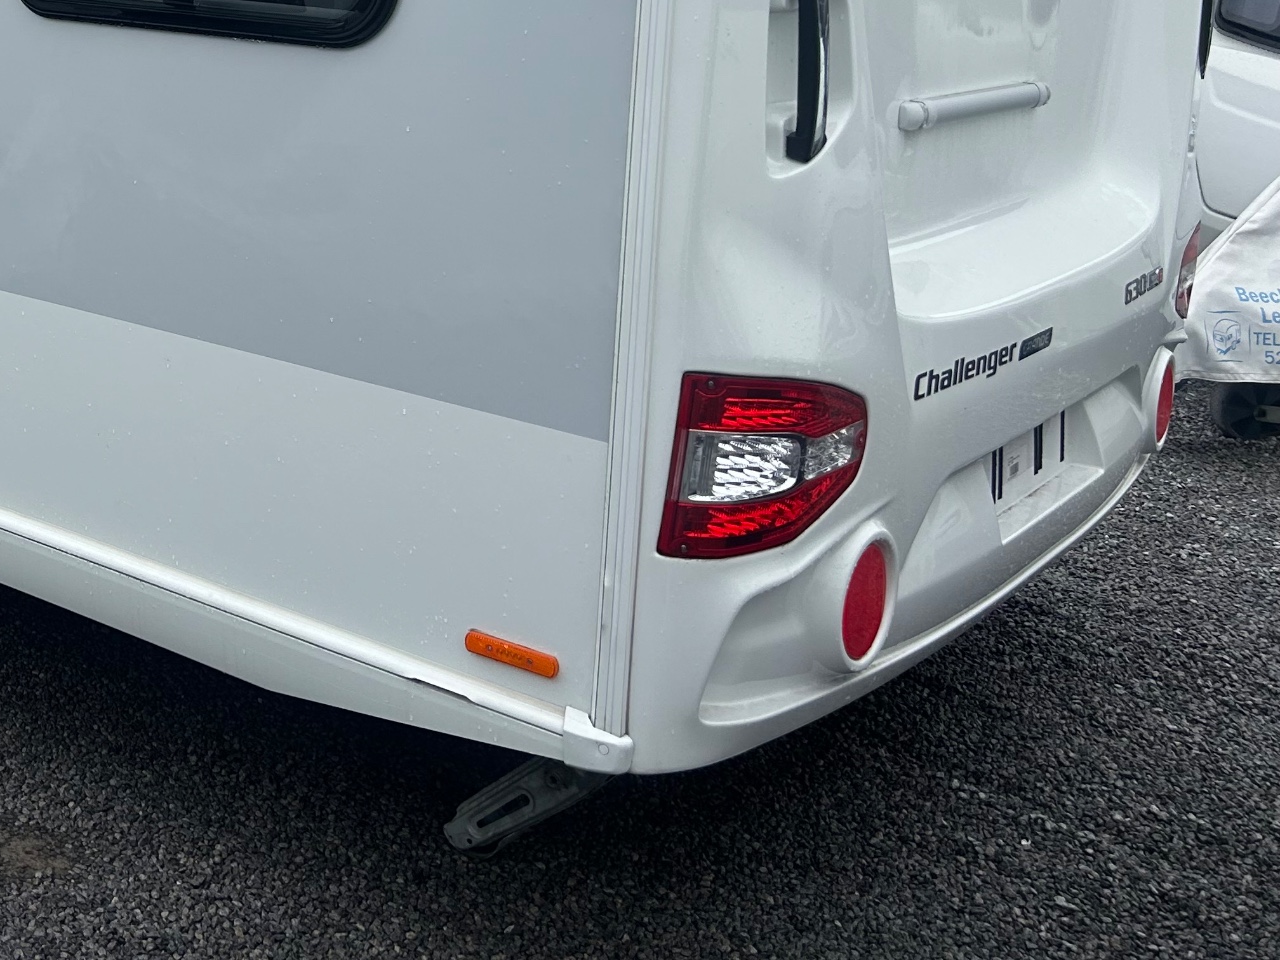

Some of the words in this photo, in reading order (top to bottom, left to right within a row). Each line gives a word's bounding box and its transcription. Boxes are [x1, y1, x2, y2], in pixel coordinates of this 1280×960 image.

[1124, 273, 1147, 306] 630
[1235, 286, 1280, 303] Beec
[913, 342, 1018, 401] Challenger
